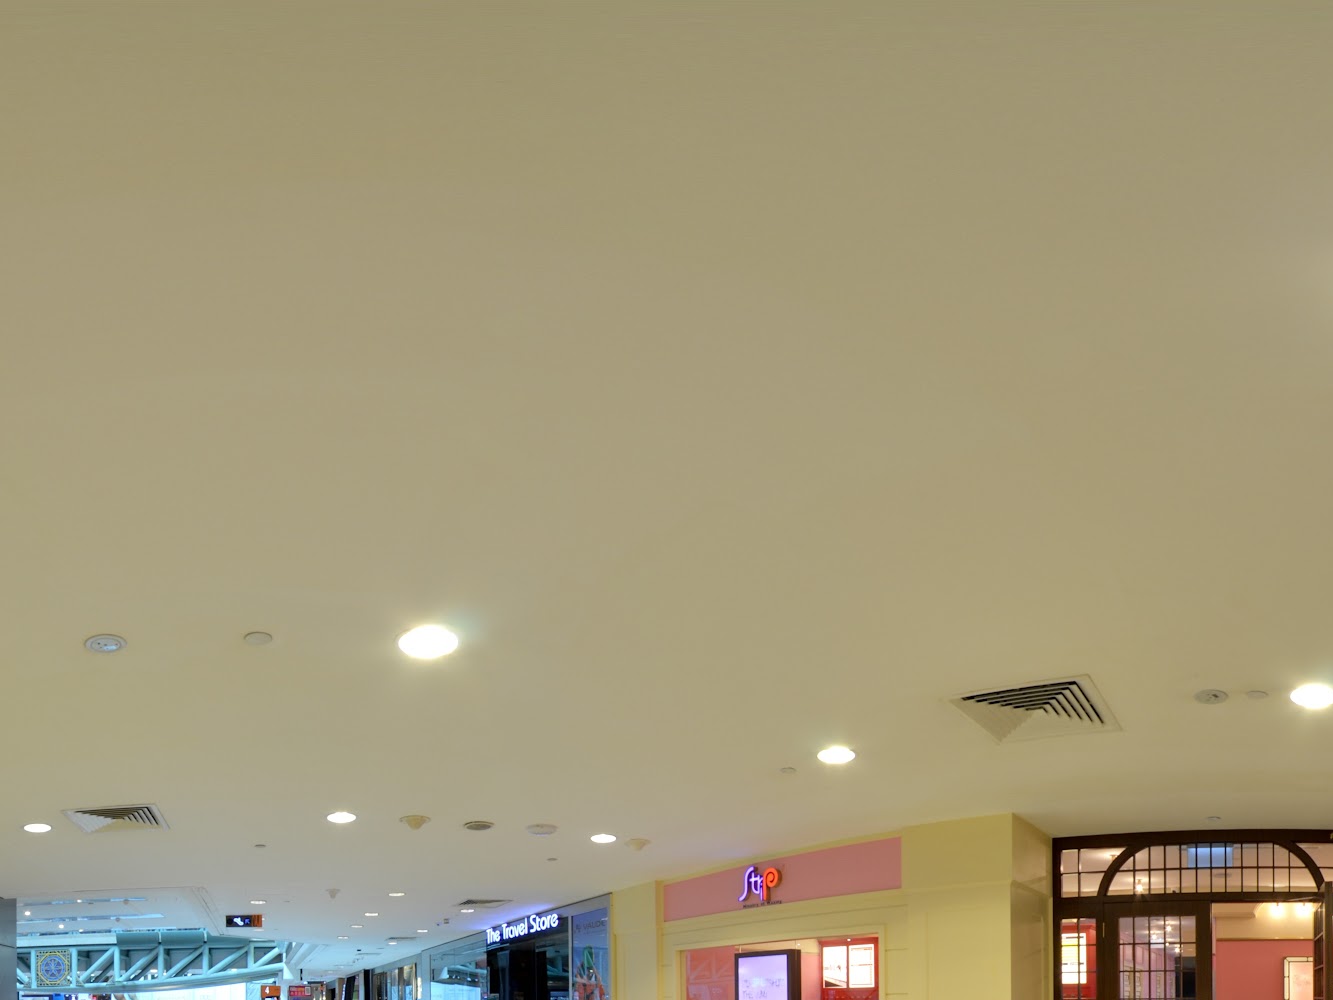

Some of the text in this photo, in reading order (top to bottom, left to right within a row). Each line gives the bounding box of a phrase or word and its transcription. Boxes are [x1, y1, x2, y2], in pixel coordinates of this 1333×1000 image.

[486, 914, 559, 944] The Travel Store
[264, 986, 270, 994] 4
